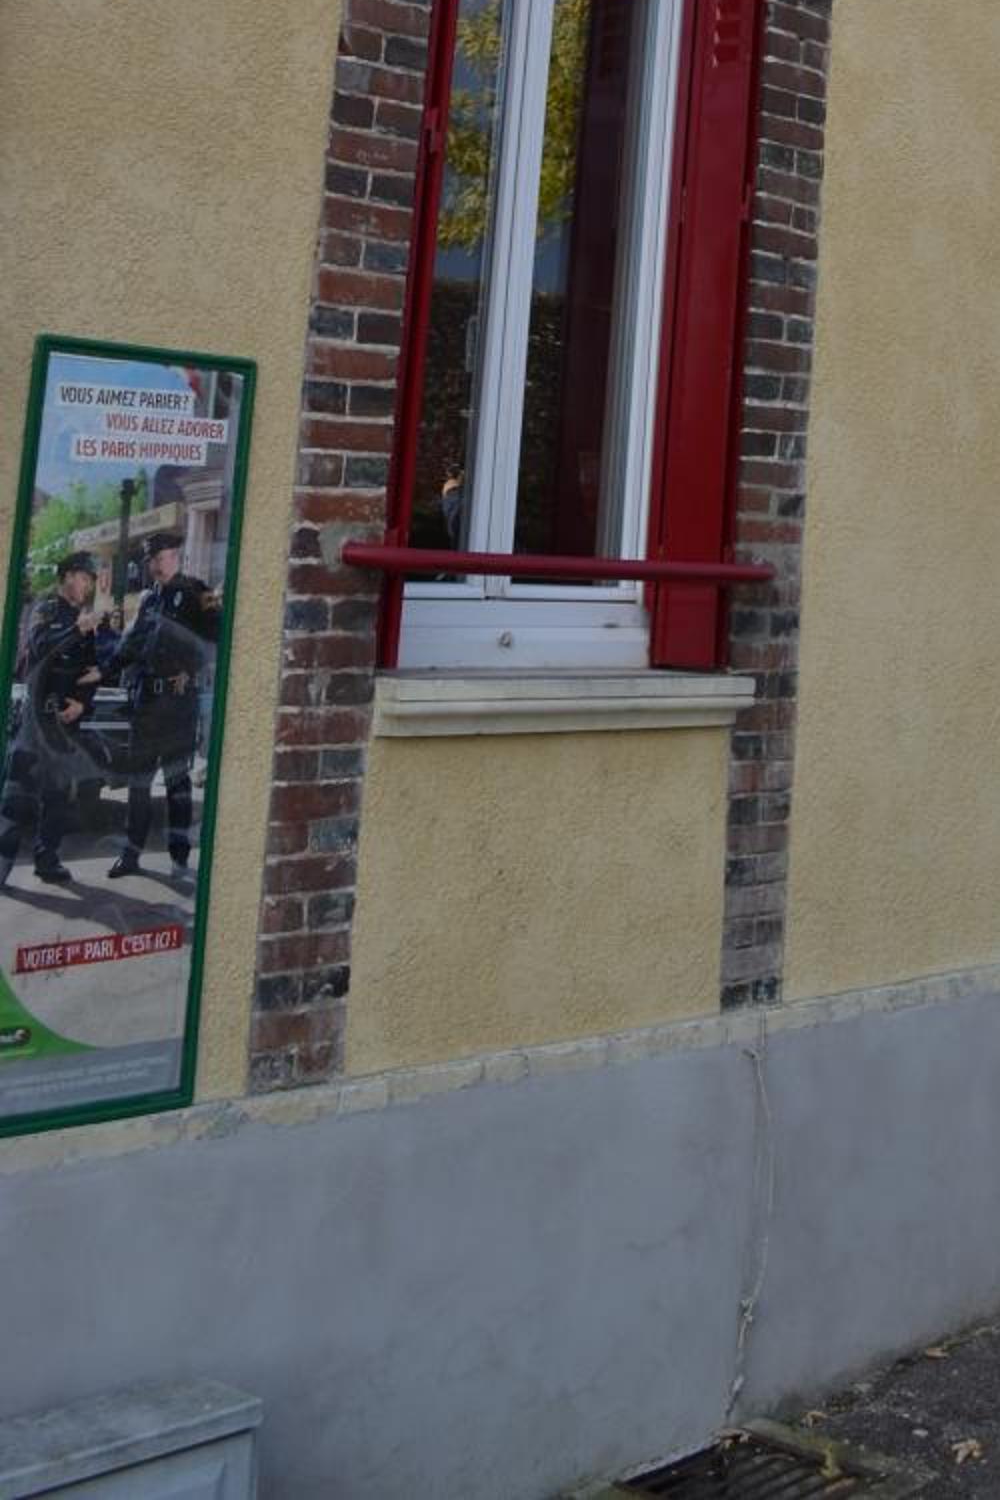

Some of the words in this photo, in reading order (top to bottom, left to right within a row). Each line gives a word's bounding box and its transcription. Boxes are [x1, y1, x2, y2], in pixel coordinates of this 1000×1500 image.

[60, 385, 93, 404] VOUS
[95, 388, 136, 408] AIMEZ
[106, 413, 138, 432] VOUS
[141, 416, 175, 435] ALLEZ
[177, 420, 224, 439] ADORER
[76, 438, 97, 456] LES
[101, 439, 136, 459] PARIS
[139, 442, 202, 462] HIPPIQUES
[23, 946, 63, 969] VOTRE
[84, 939, 118, 960] PARI,
[121, 932, 153, 953] C'EST
